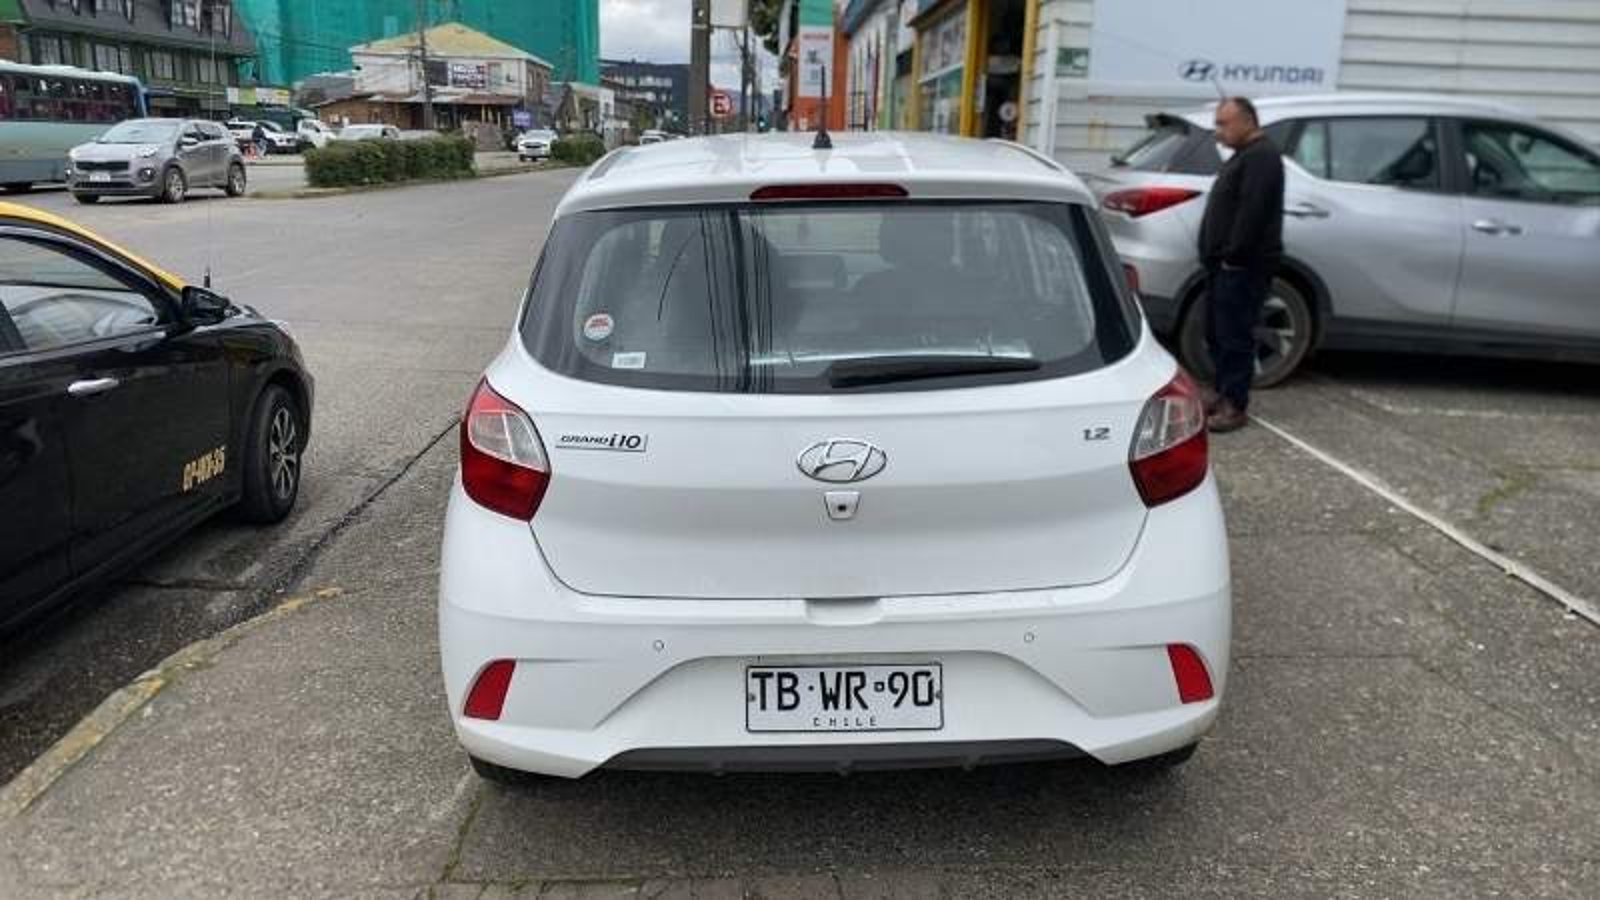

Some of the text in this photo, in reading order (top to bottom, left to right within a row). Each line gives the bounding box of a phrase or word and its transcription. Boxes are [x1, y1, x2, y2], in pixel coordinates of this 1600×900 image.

[1223, 64, 1325, 84] HYUNDAI
[609, 433, 642, 449] i10
[813, 716, 878, 727] CHILE
